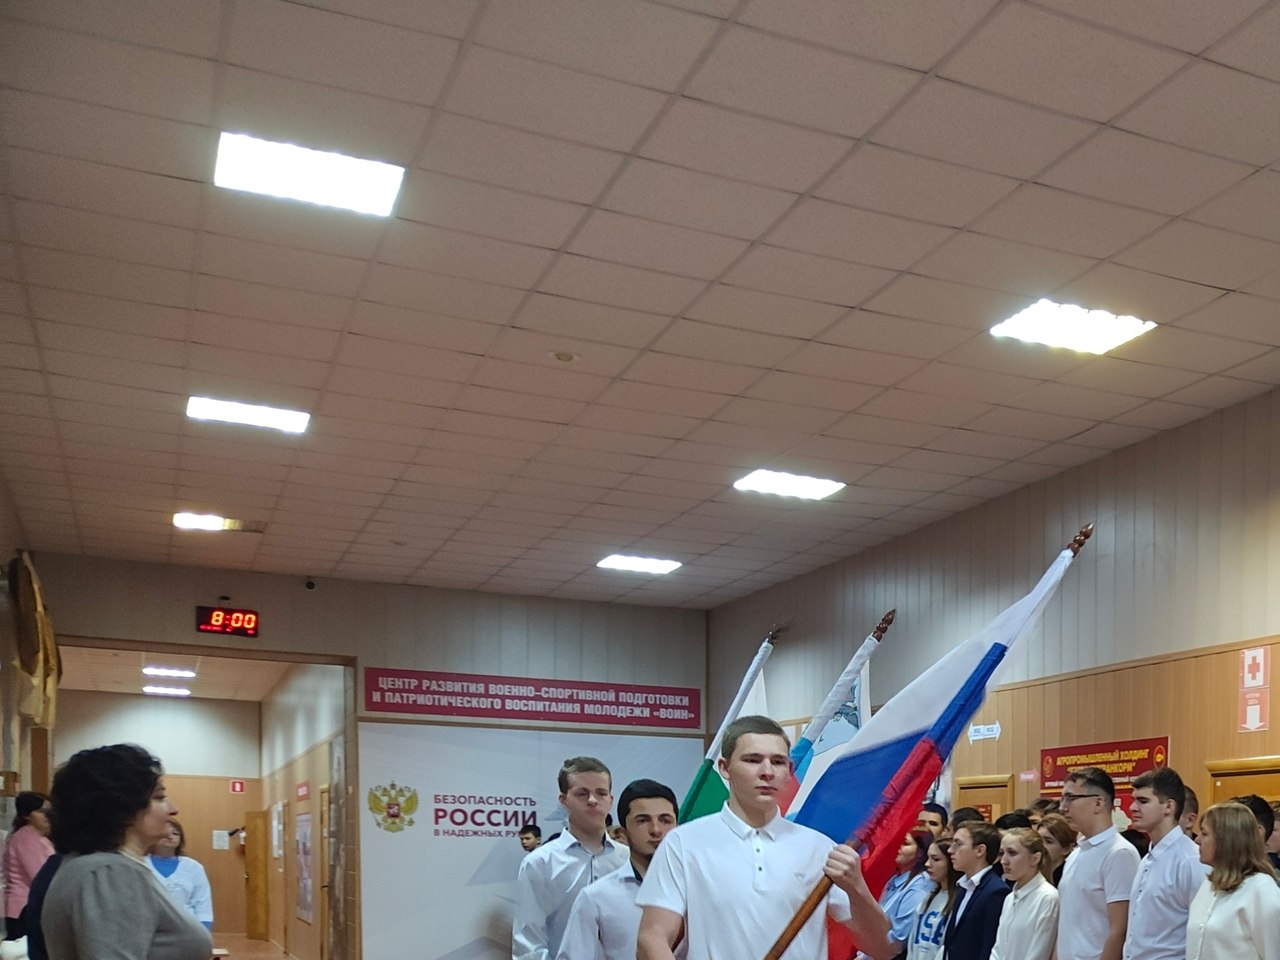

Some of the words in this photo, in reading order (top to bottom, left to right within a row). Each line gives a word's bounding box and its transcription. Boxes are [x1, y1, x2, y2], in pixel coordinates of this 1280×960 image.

[210, 611, 257, 629] 8:00
[378, 677, 418, 690] ЦЕНТР
[422, 679, 485, 694] РАЗВИТИЯ
[618, 691, 690, 706] ПОДГОТОВКИ
[372, 691, 381, 703] И
[384, 692, 502, 709] ПАТРИОТИЧЕСКОГО
[504, 699, 581, 714] ВОСПИТАНИЯ
[584, 703, 650, 718] МОЛОДЕЖИ
[653, 708, 695, 719] «ВОИН»
[433, 794, 537, 807] БЕЗОПАСНОСТЬ
[434, 808, 537, 827] РОССИИ
[442, 829, 503, 838] НАДЕЖНЫХ
